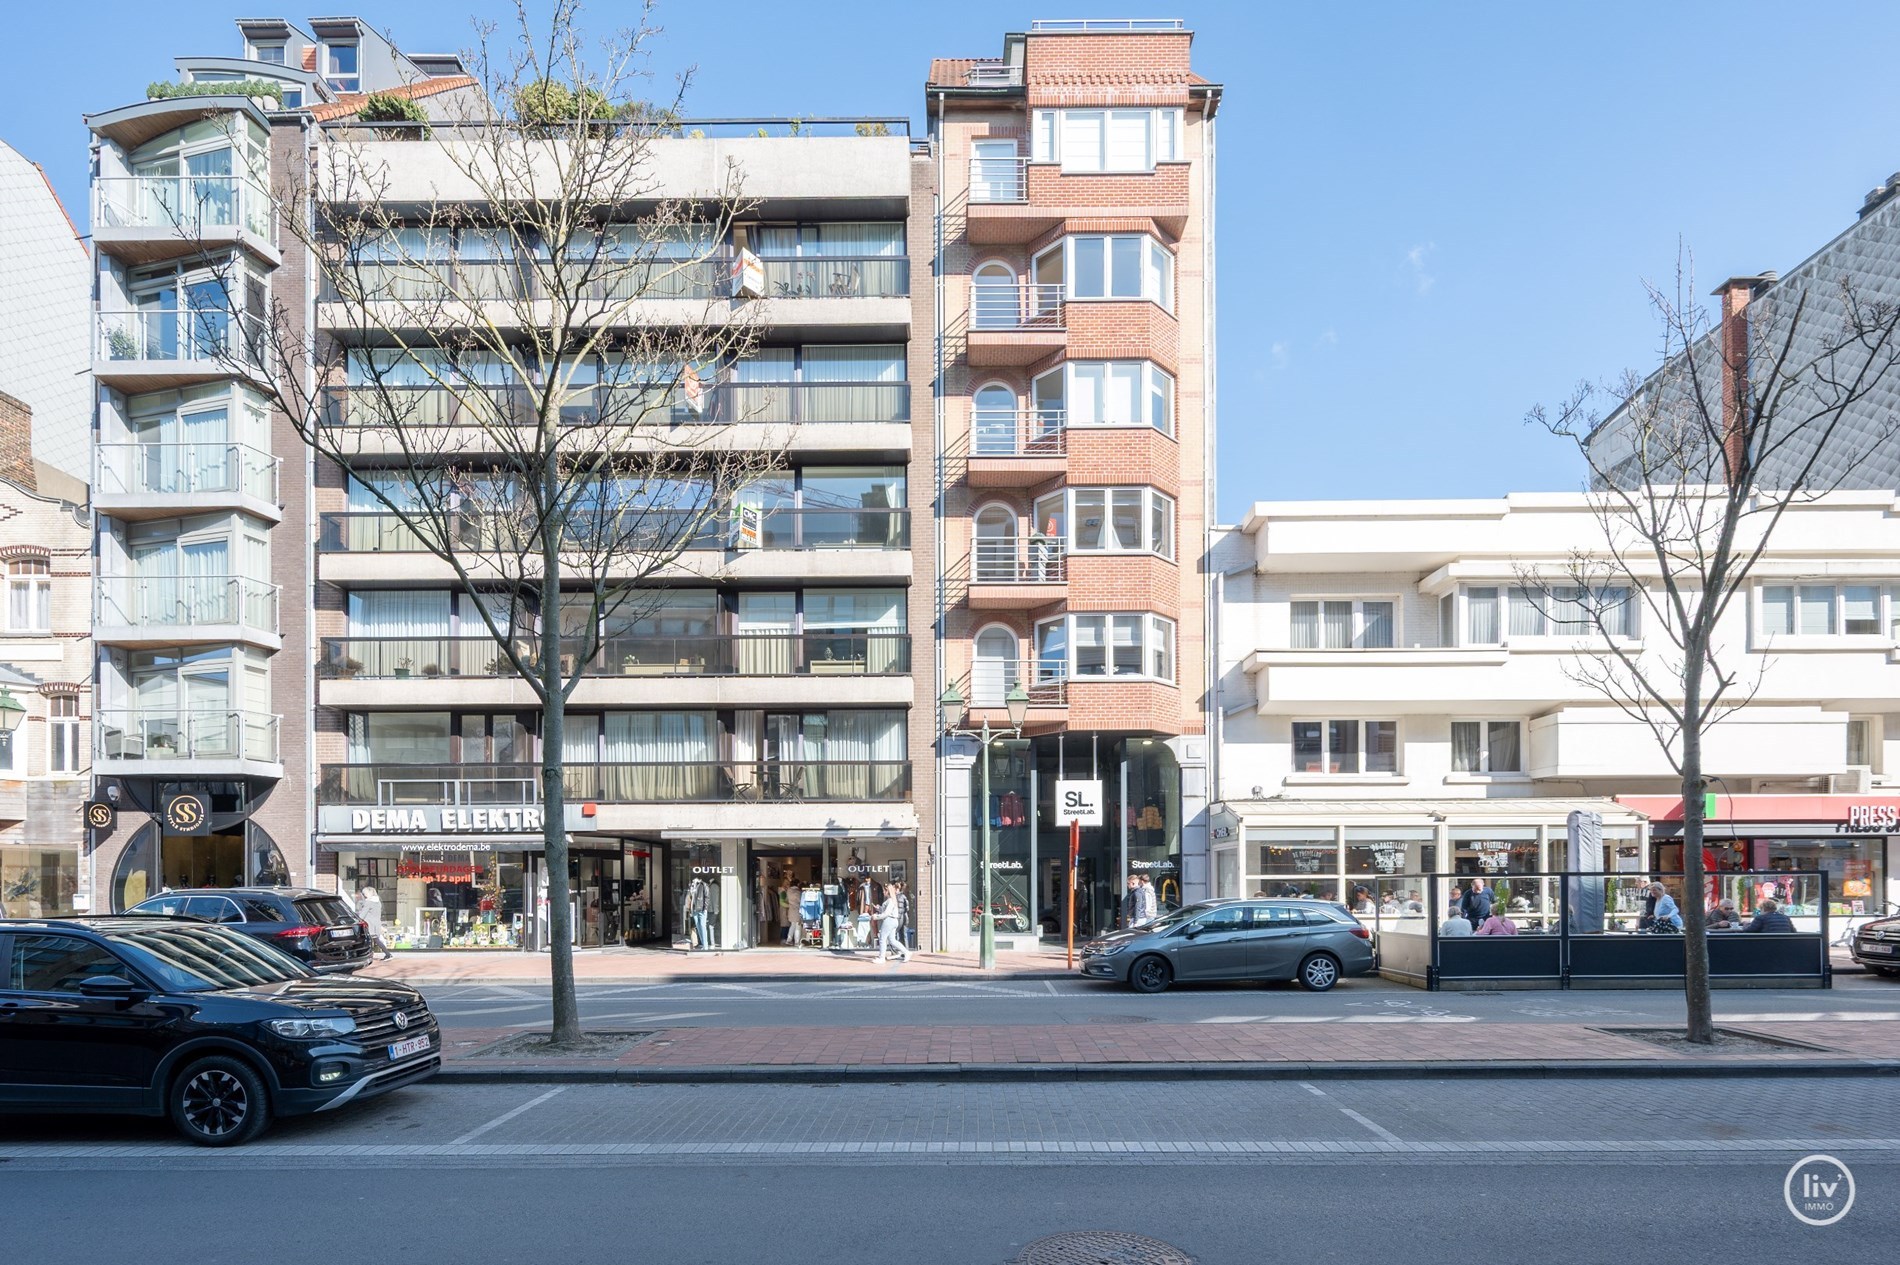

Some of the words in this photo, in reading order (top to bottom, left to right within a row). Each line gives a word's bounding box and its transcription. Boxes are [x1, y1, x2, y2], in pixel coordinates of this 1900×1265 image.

[1065, 791, 1094, 807] SL.
[352, 808, 428, 831] DEMA
[440, 808, 545, 831] ELEKTR
[1850, 805, 1897, 827] PRESS
[401, 842, 491, 852] www.elektrodema.be
[848, 865, 890, 873] OUTLET
[980, 861, 1023, 869] SreetLab.
[1131, 860, 1175, 869] StreetLab.
[692, 866, 735, 874] OUTLET
[436, 875, 447, 883] 12
[449, 875, 471, 885] april
